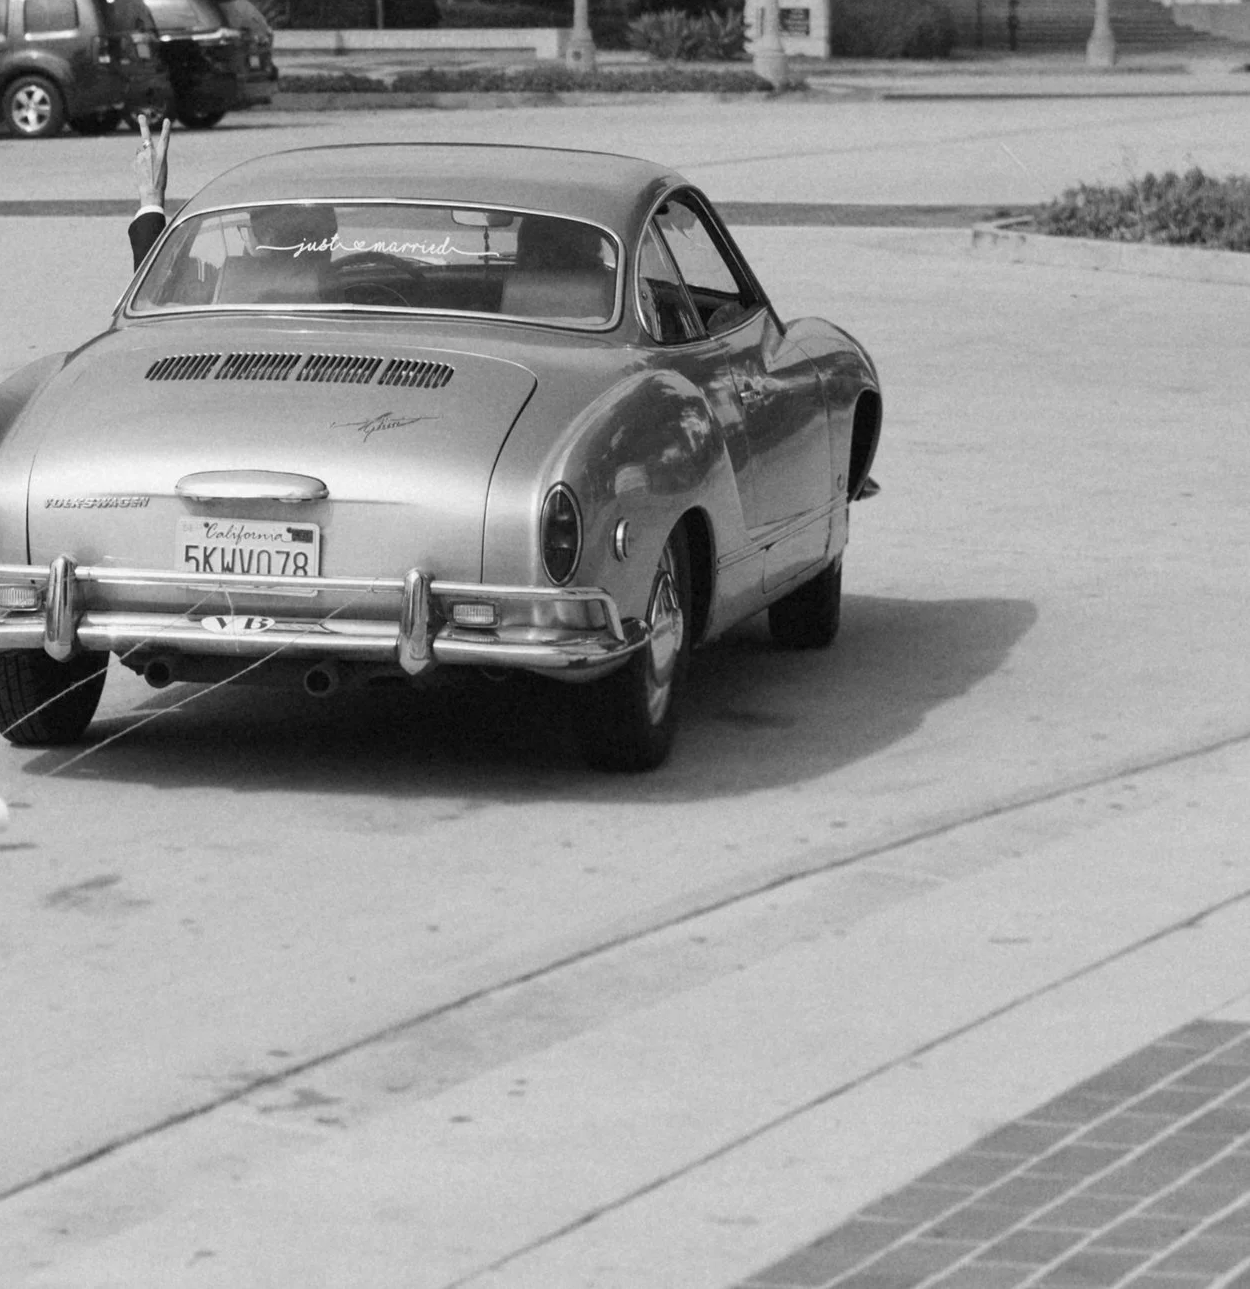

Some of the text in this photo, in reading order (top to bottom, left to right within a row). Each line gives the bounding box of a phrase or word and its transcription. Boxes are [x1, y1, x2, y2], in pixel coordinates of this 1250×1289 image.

[291, 233, 456, 258] just married
[44, 496, 150, 509] VOLKSWAGEN
[205, 522, 290, 545] California
